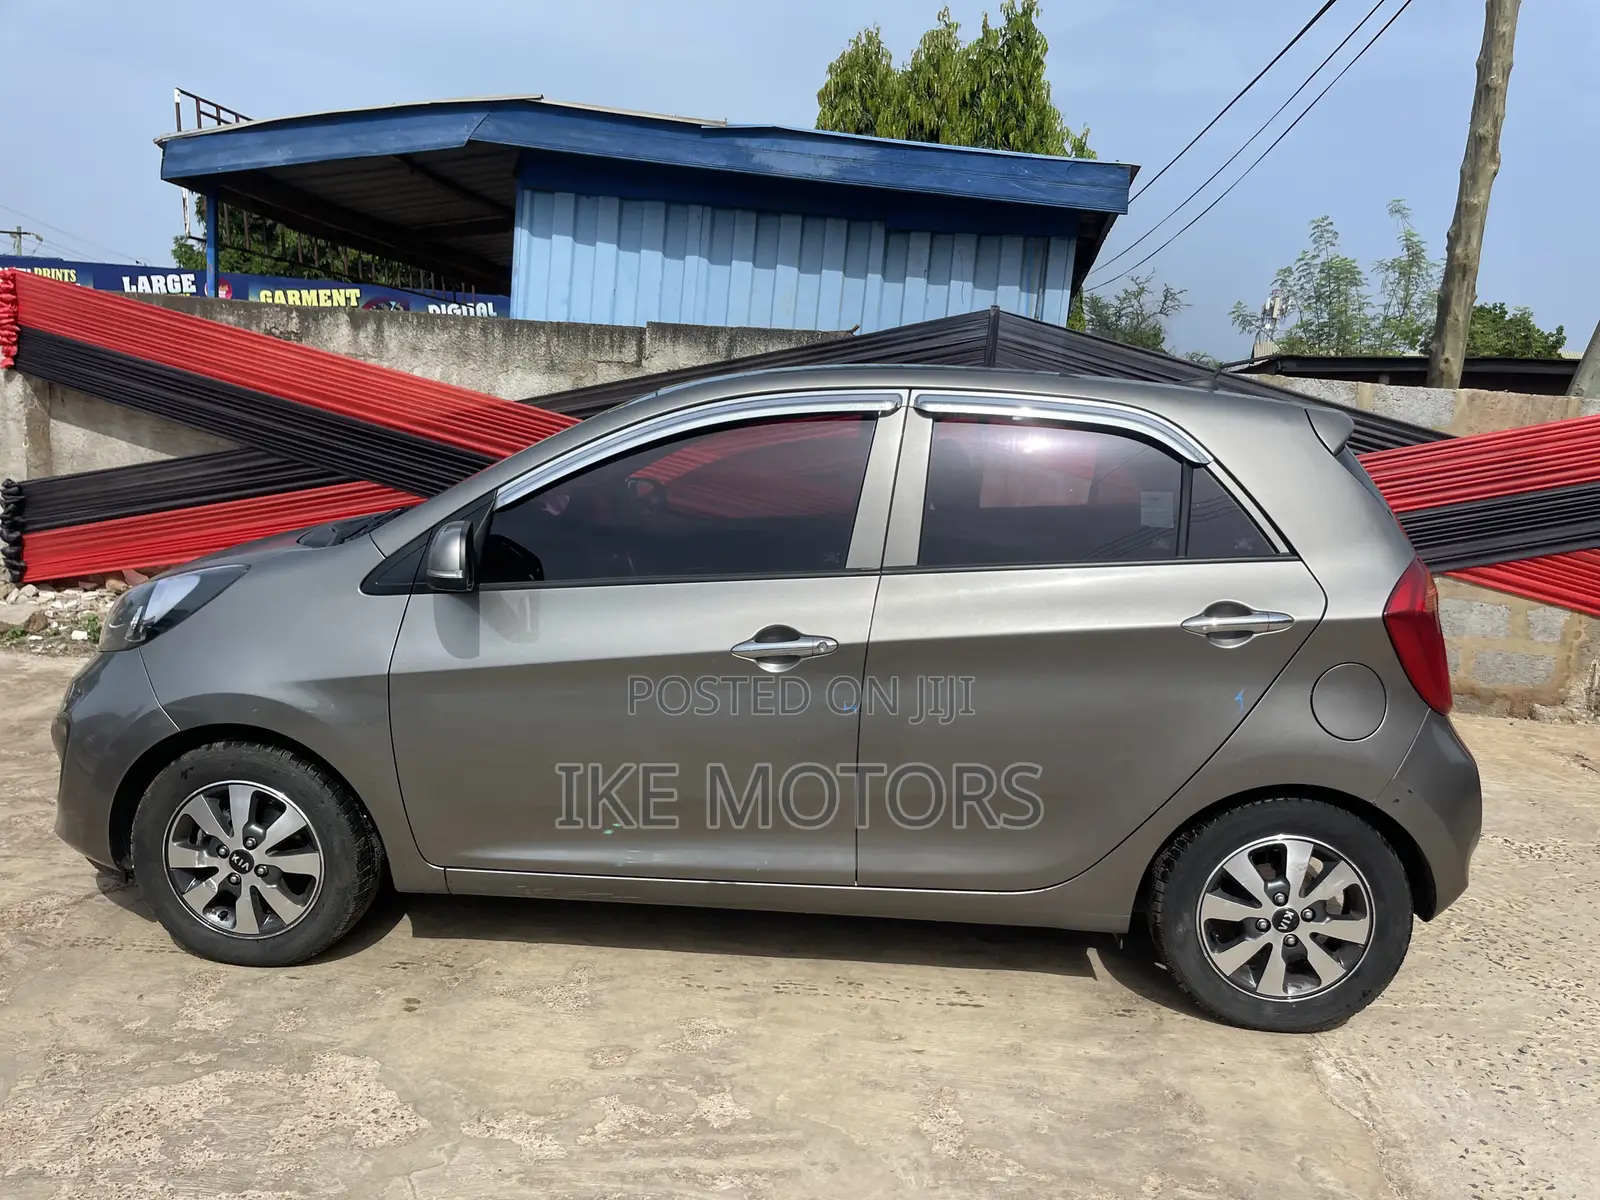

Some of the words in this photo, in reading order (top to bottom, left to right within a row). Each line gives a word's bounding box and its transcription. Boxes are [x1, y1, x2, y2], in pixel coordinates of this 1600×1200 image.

[122, 273, 197, 294] LARGE
[259, 288, 361, 307] GARMENT
[231, 853, 249, 871] KIA
[1278, 910, 1294, 929] KIA
